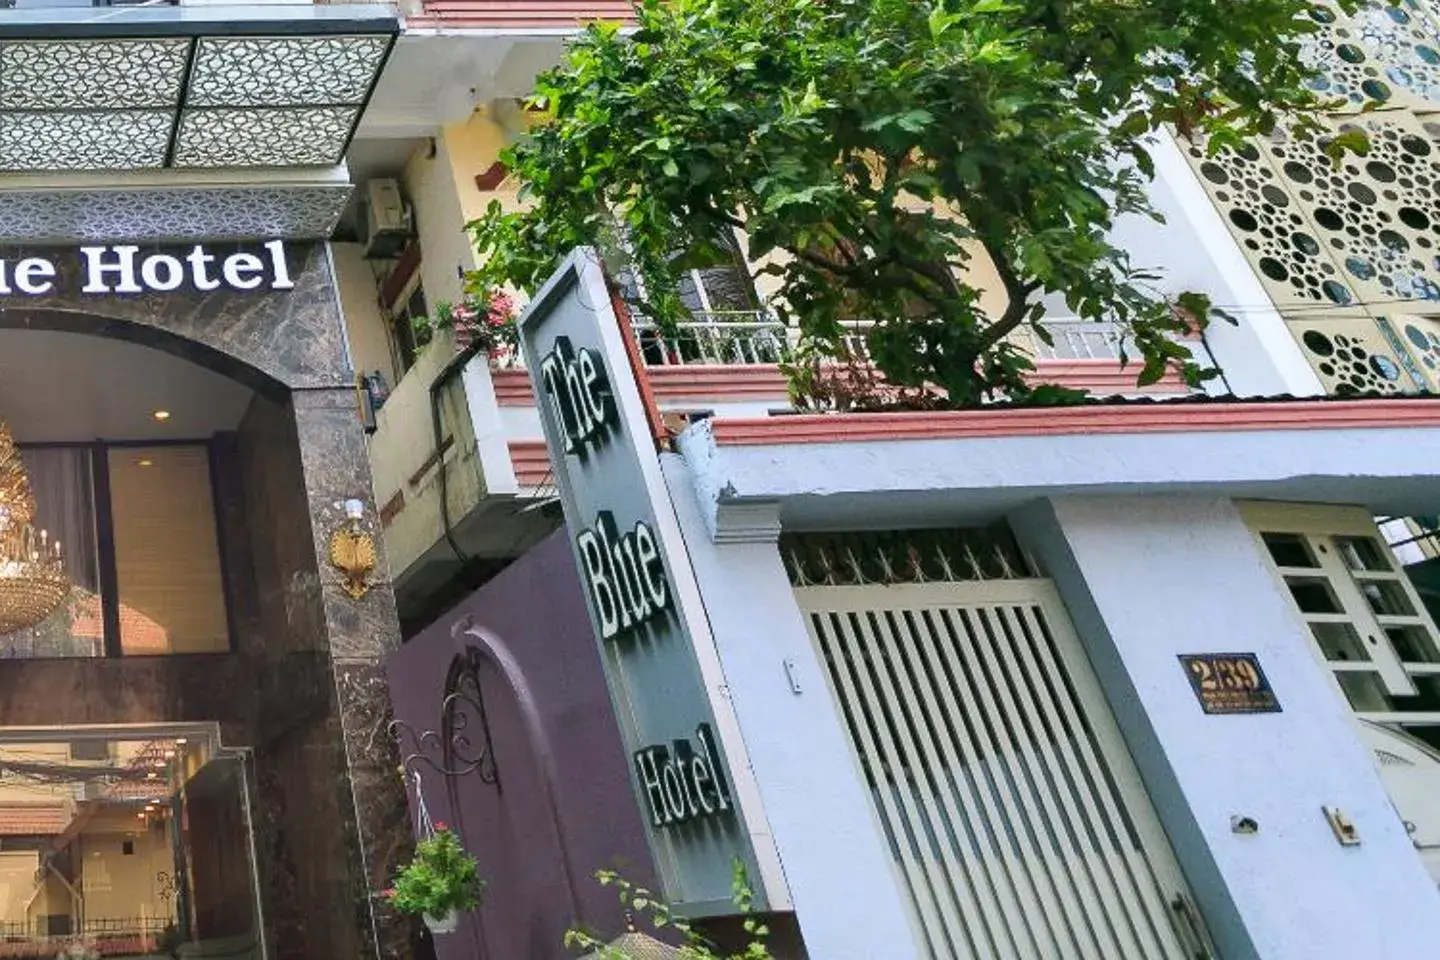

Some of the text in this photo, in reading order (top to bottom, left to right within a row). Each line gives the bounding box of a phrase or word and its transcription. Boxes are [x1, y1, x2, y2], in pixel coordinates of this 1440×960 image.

[80, 239, 295, 294] Hotel
[541, 337, 613, 453] The
[577, 511, 670, 639] Blue
[634, 724, 730, 826] Hotel
